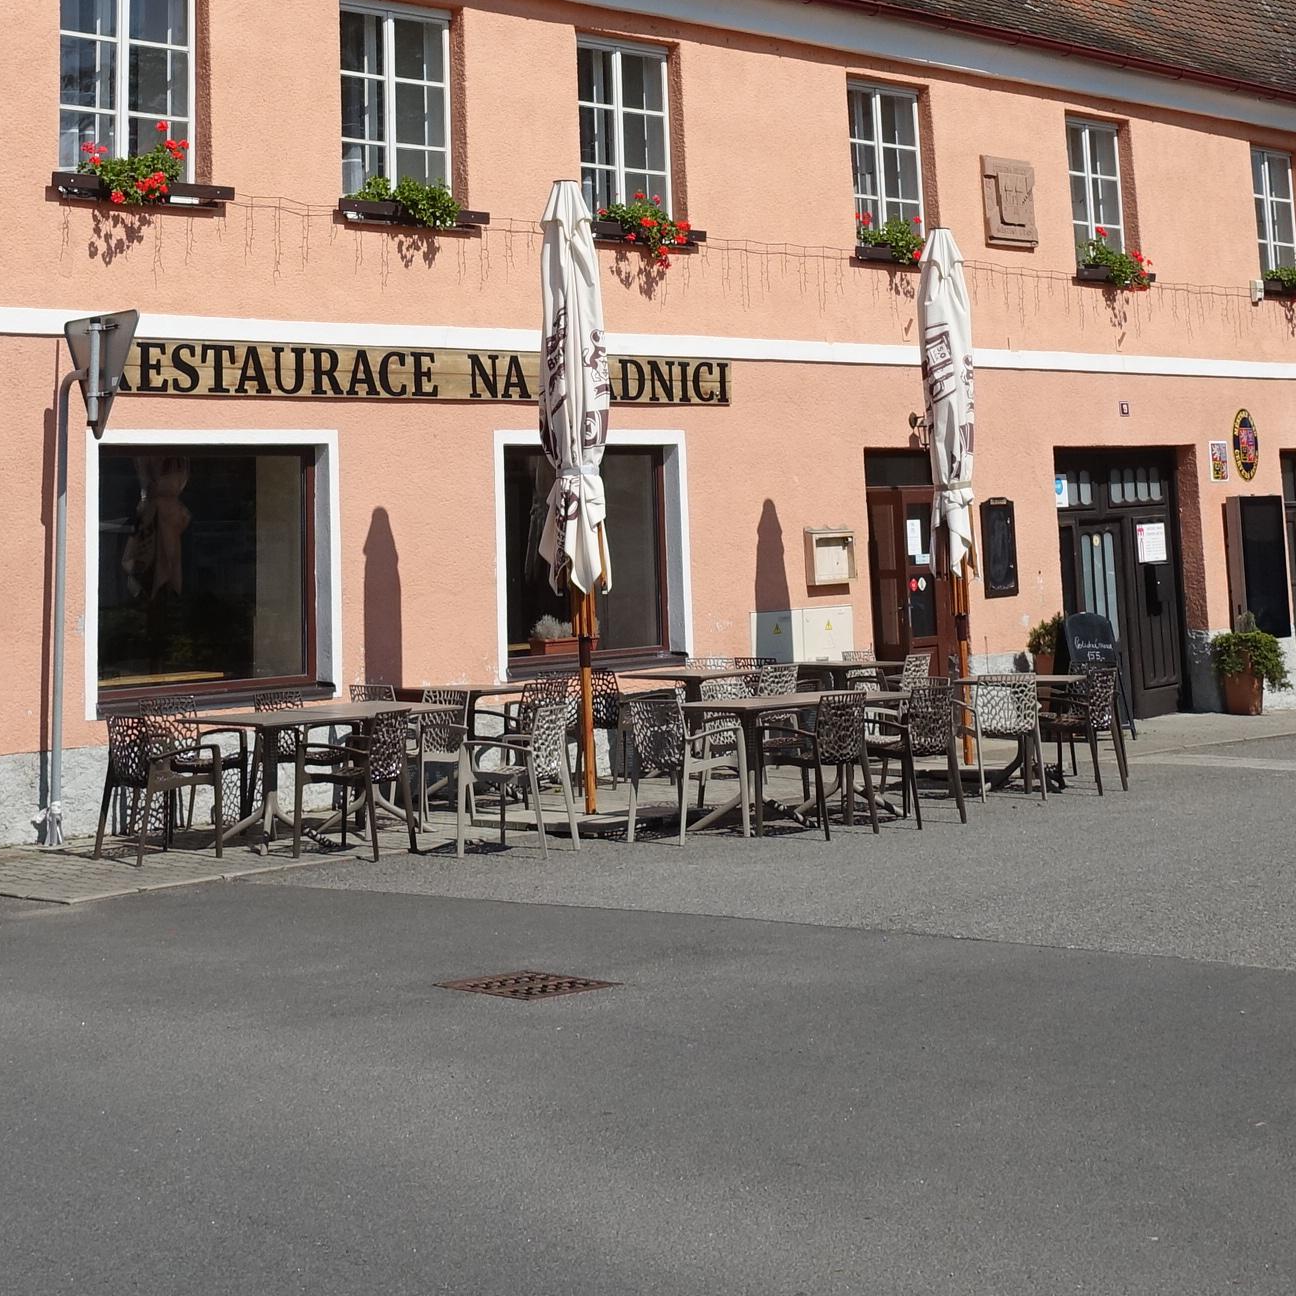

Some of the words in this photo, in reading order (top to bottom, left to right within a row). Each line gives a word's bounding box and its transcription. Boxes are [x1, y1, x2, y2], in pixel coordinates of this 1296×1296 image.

[118, 342, 438, 397] ESTAURACE
[468, 354, 531, 399] NA
[610, 358, 729, 403] DNICI
